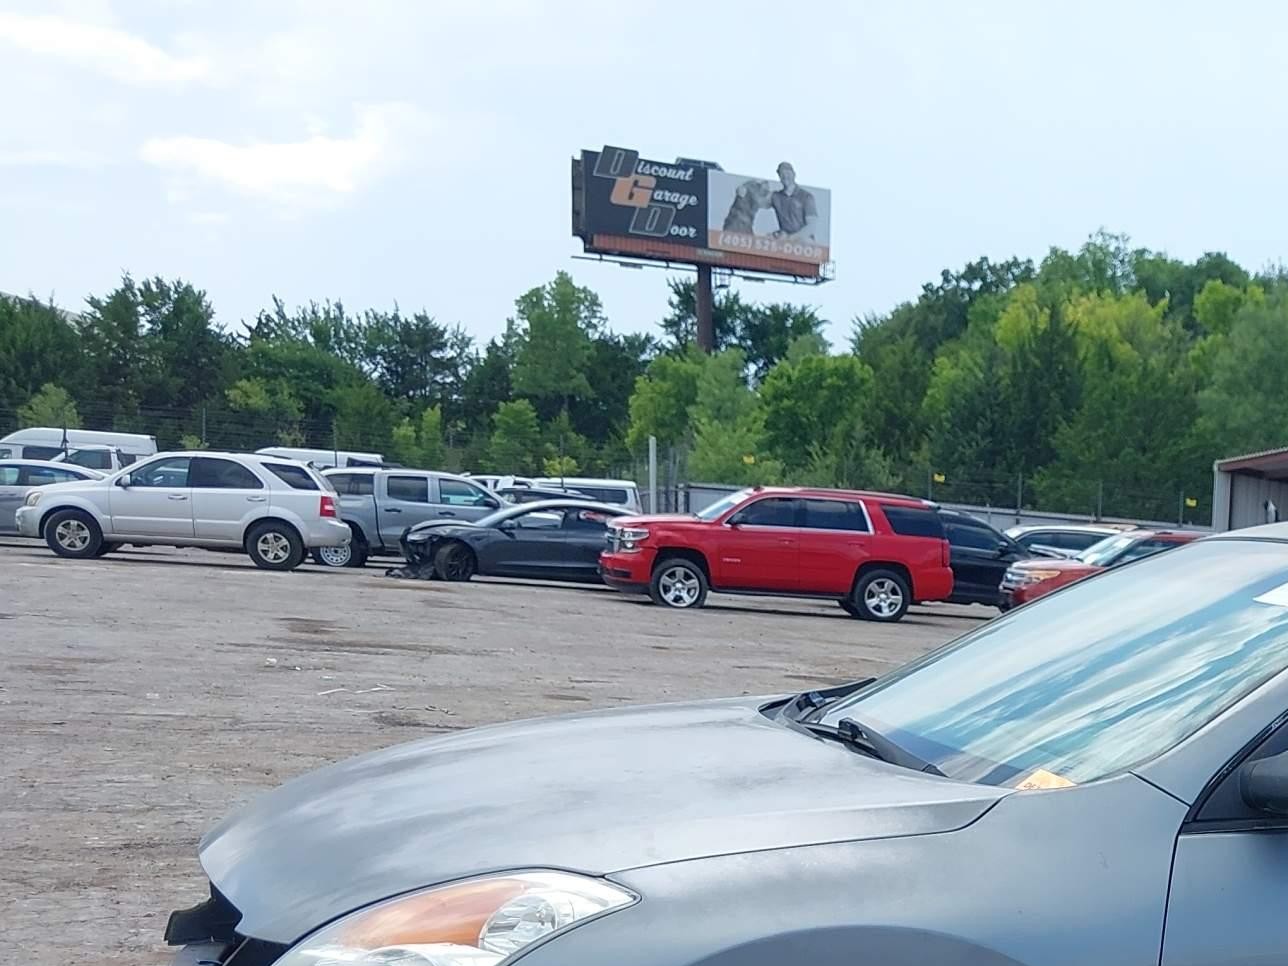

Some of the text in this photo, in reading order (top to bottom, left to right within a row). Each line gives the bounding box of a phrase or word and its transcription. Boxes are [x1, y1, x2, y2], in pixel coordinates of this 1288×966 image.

[593, 145, 694, 180] Discount
[610, 174, 698, 210] Garage
[629, 202, 697, 238] Door
